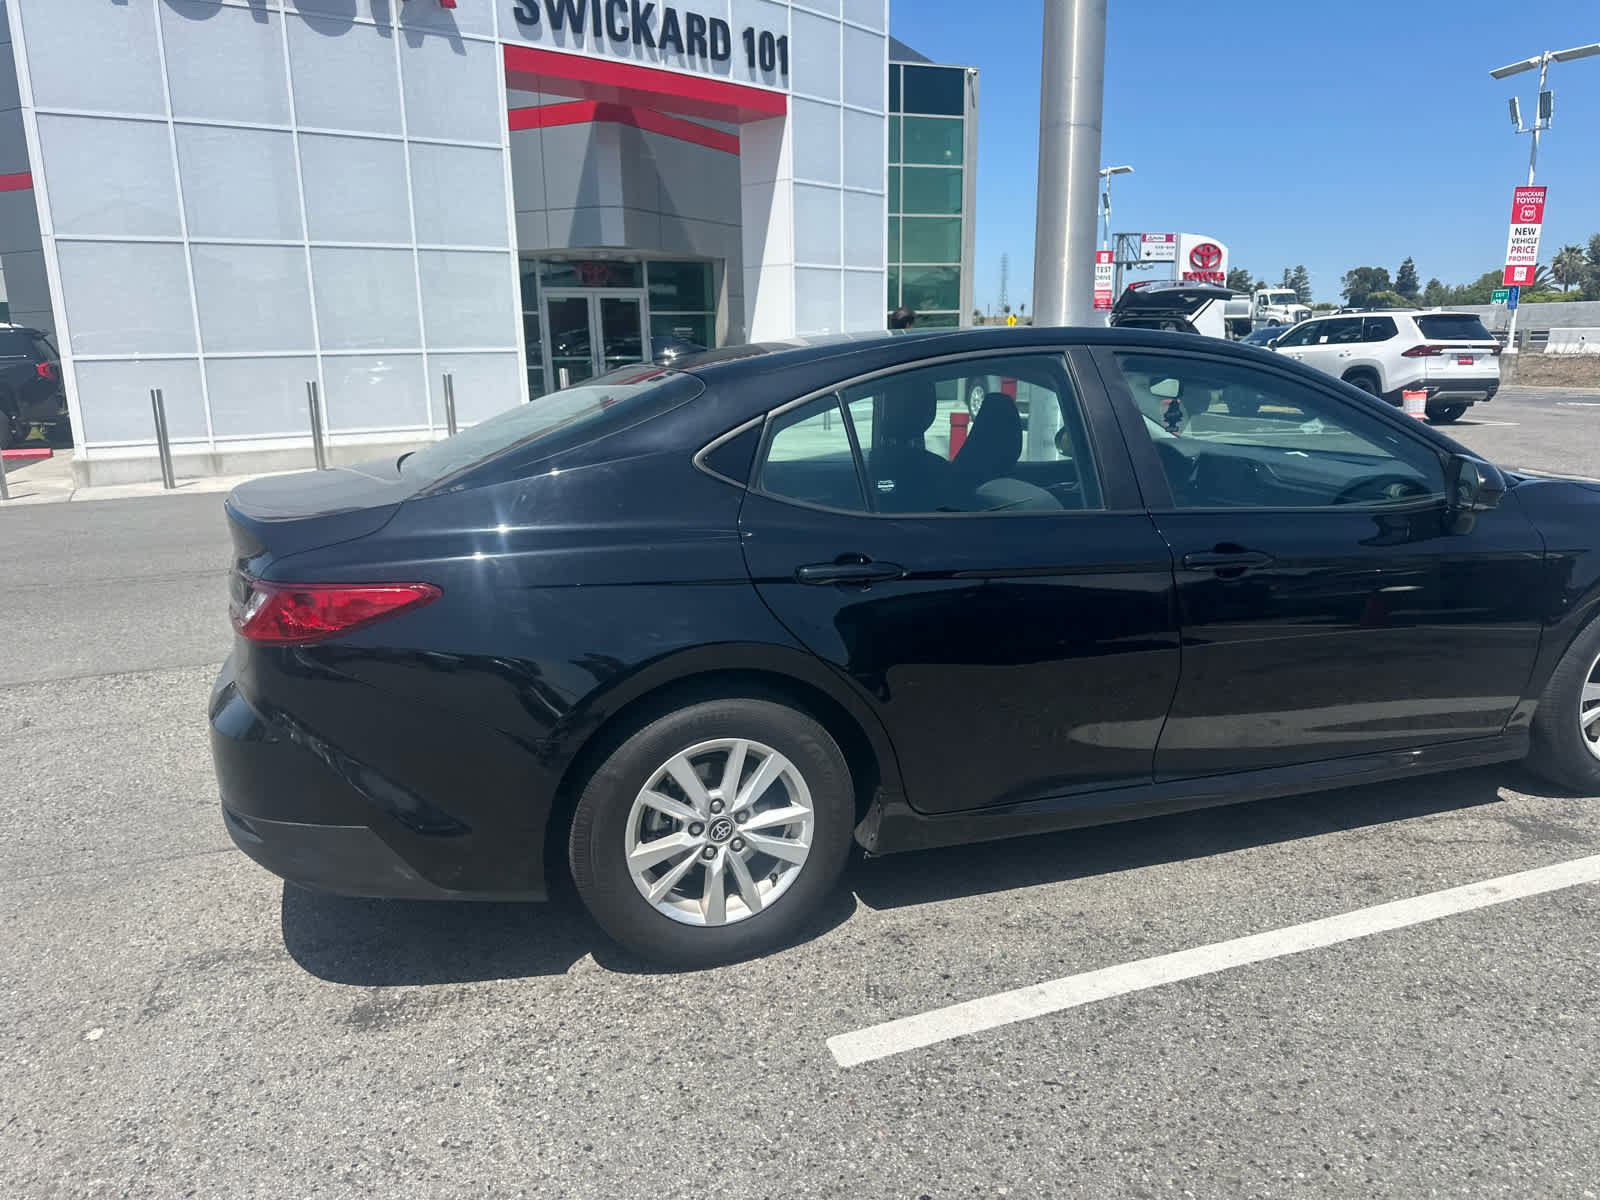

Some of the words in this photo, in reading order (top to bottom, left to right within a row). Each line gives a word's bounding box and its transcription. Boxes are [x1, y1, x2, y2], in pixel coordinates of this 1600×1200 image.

[513, 0, 731, 61] SWICKARD
[742, 26, 788, 75] 101
[1514, 227, 1537, 236] NEW
[1510, 246, 1535, 254] PRICE
[1182, 271, 1225, 281] TOYOTA
